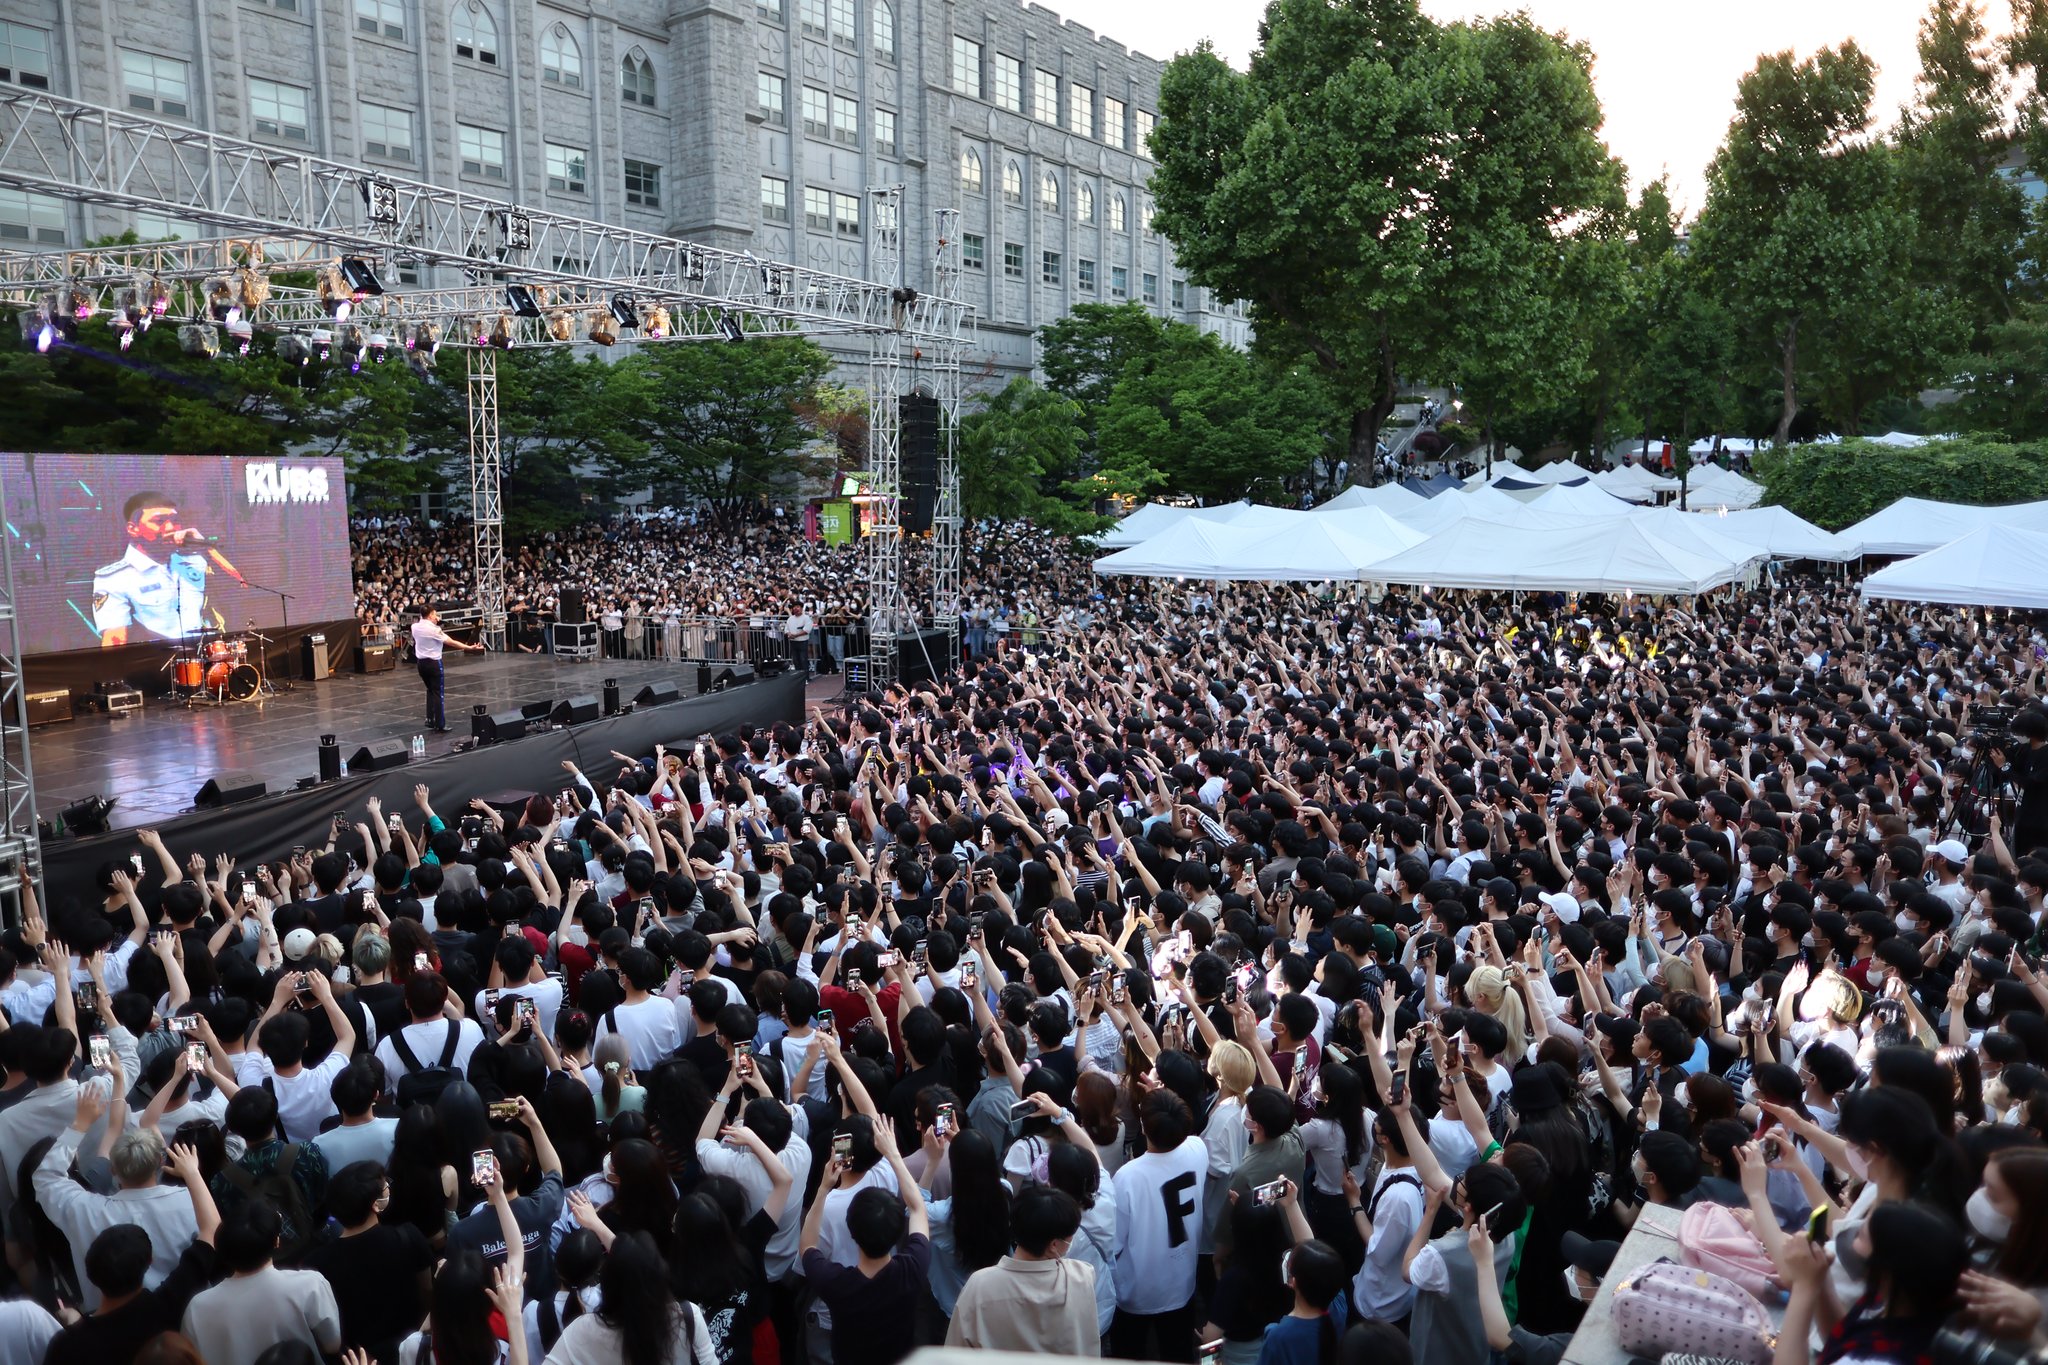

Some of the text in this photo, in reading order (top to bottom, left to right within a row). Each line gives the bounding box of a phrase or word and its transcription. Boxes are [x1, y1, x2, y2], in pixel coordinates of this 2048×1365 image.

[245, 463, 329, 497] KUBS
[1160, 1171, 1197, 1249] F
[481, 1230, 540, 1254] Baleaga
